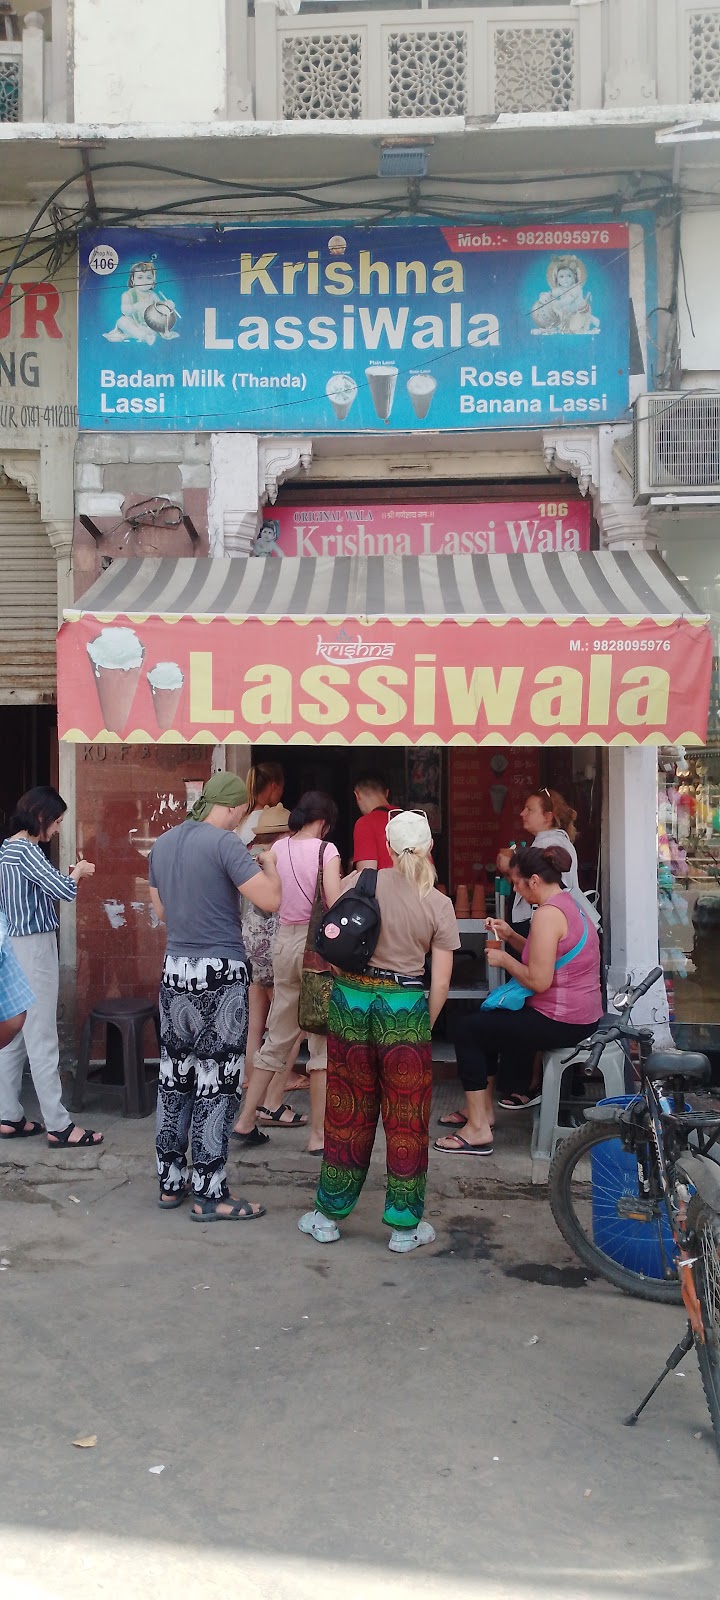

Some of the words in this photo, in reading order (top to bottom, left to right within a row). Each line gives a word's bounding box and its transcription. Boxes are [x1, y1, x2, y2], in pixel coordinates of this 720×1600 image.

[516, 230, 610, 246] 9828095976
[93, 258, 114, 270] 106
[239, 251, 465, 296] Krishna
[203, 303, 500, 350] LassiWala
[100, 369, 175, 388] Badam
[182, 369, 225, 388] Milk
[232, 372, 307, 391] (Thanda)
[460, 366, 524, 387] Rose
[531, 365, 597, 387] Lassi
[100, 393, 165, 413] Lassi
[460, 395, 542, 413] Banana
[549, 393, 607, 412] Lassi
[293, 510, 343, 523] ORIGINAL
[344, 510, 374, 522] WALA
[537, 502, 569, 517] 106
[293, 524, 411, 557] Krishna
[421, 521, 497, 554] Lassi
[505, 519, 581, 553] Wala
[315, 634, 396, 665] krishna
[593, 640, 671, 652] 9828095976
[189, 651, 671, 725] Lassiwala
